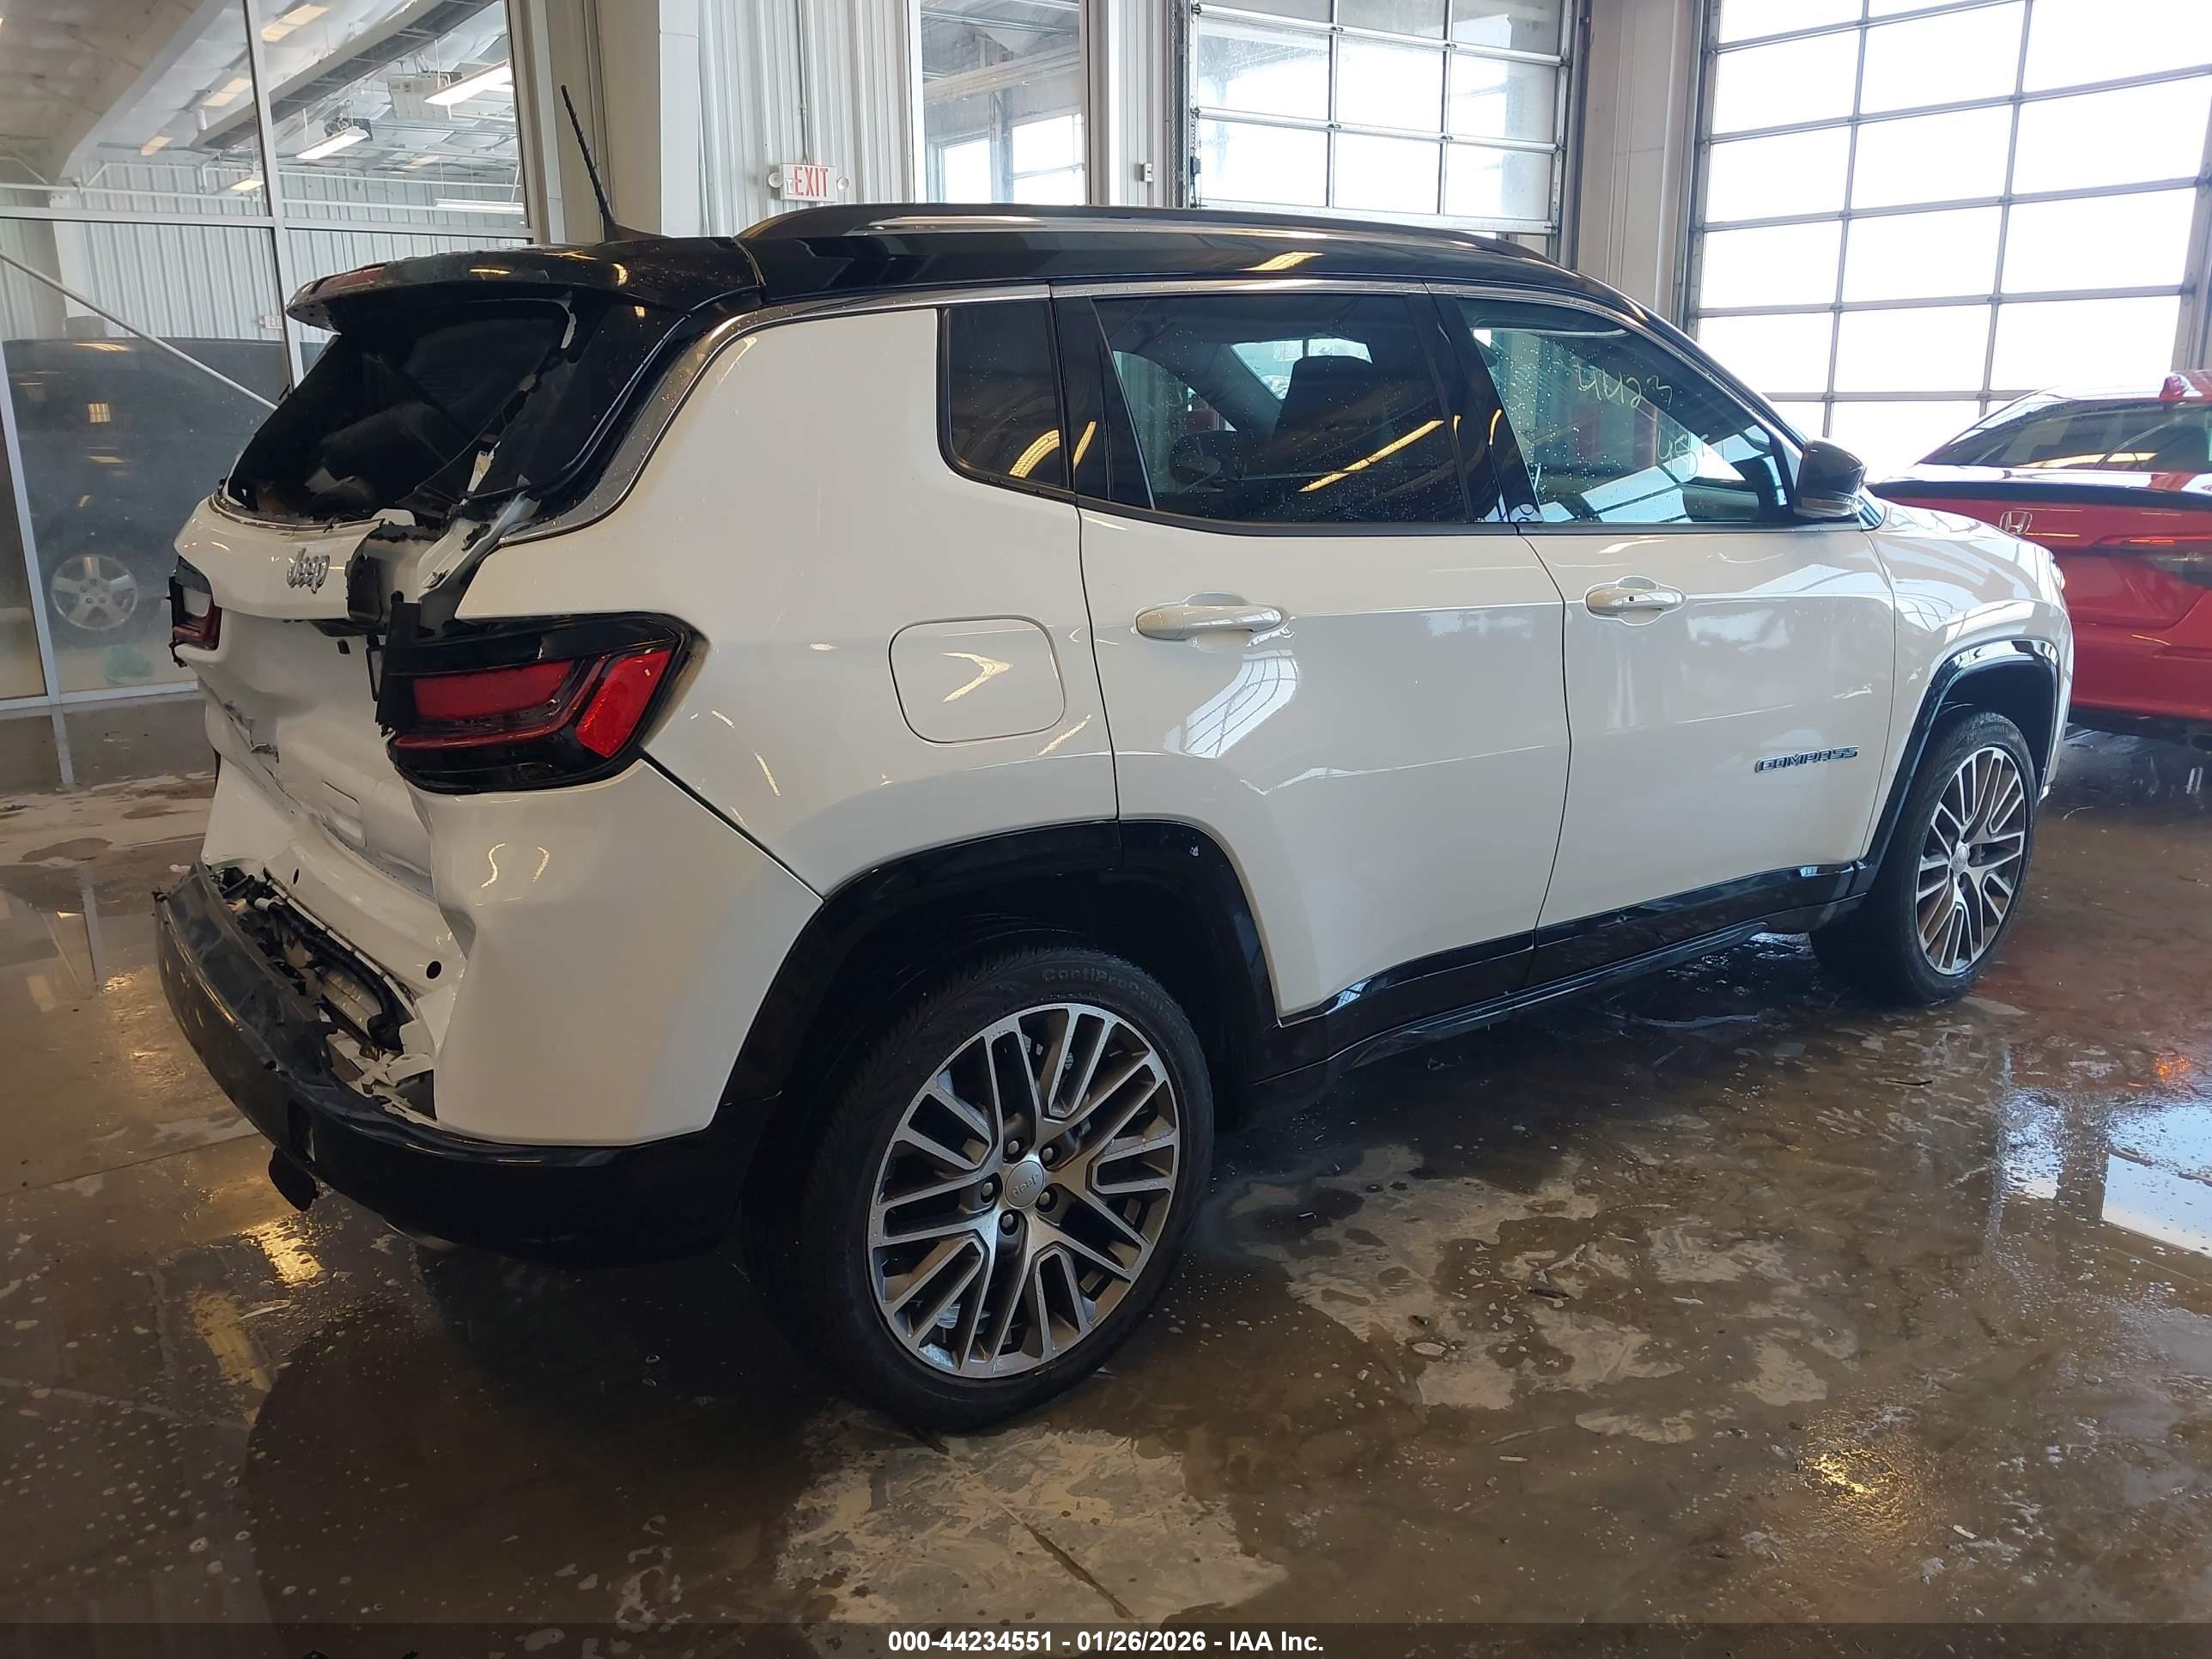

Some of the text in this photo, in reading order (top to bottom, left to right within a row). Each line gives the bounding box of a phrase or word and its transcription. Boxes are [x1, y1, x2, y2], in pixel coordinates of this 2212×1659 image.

[793, 166, 829, 197] EXIT
[1573, 364, 1673, 409] 4423
[286, 547, 331, 594] Jeep
[1754, 744, 1860, 774] COMPASS
